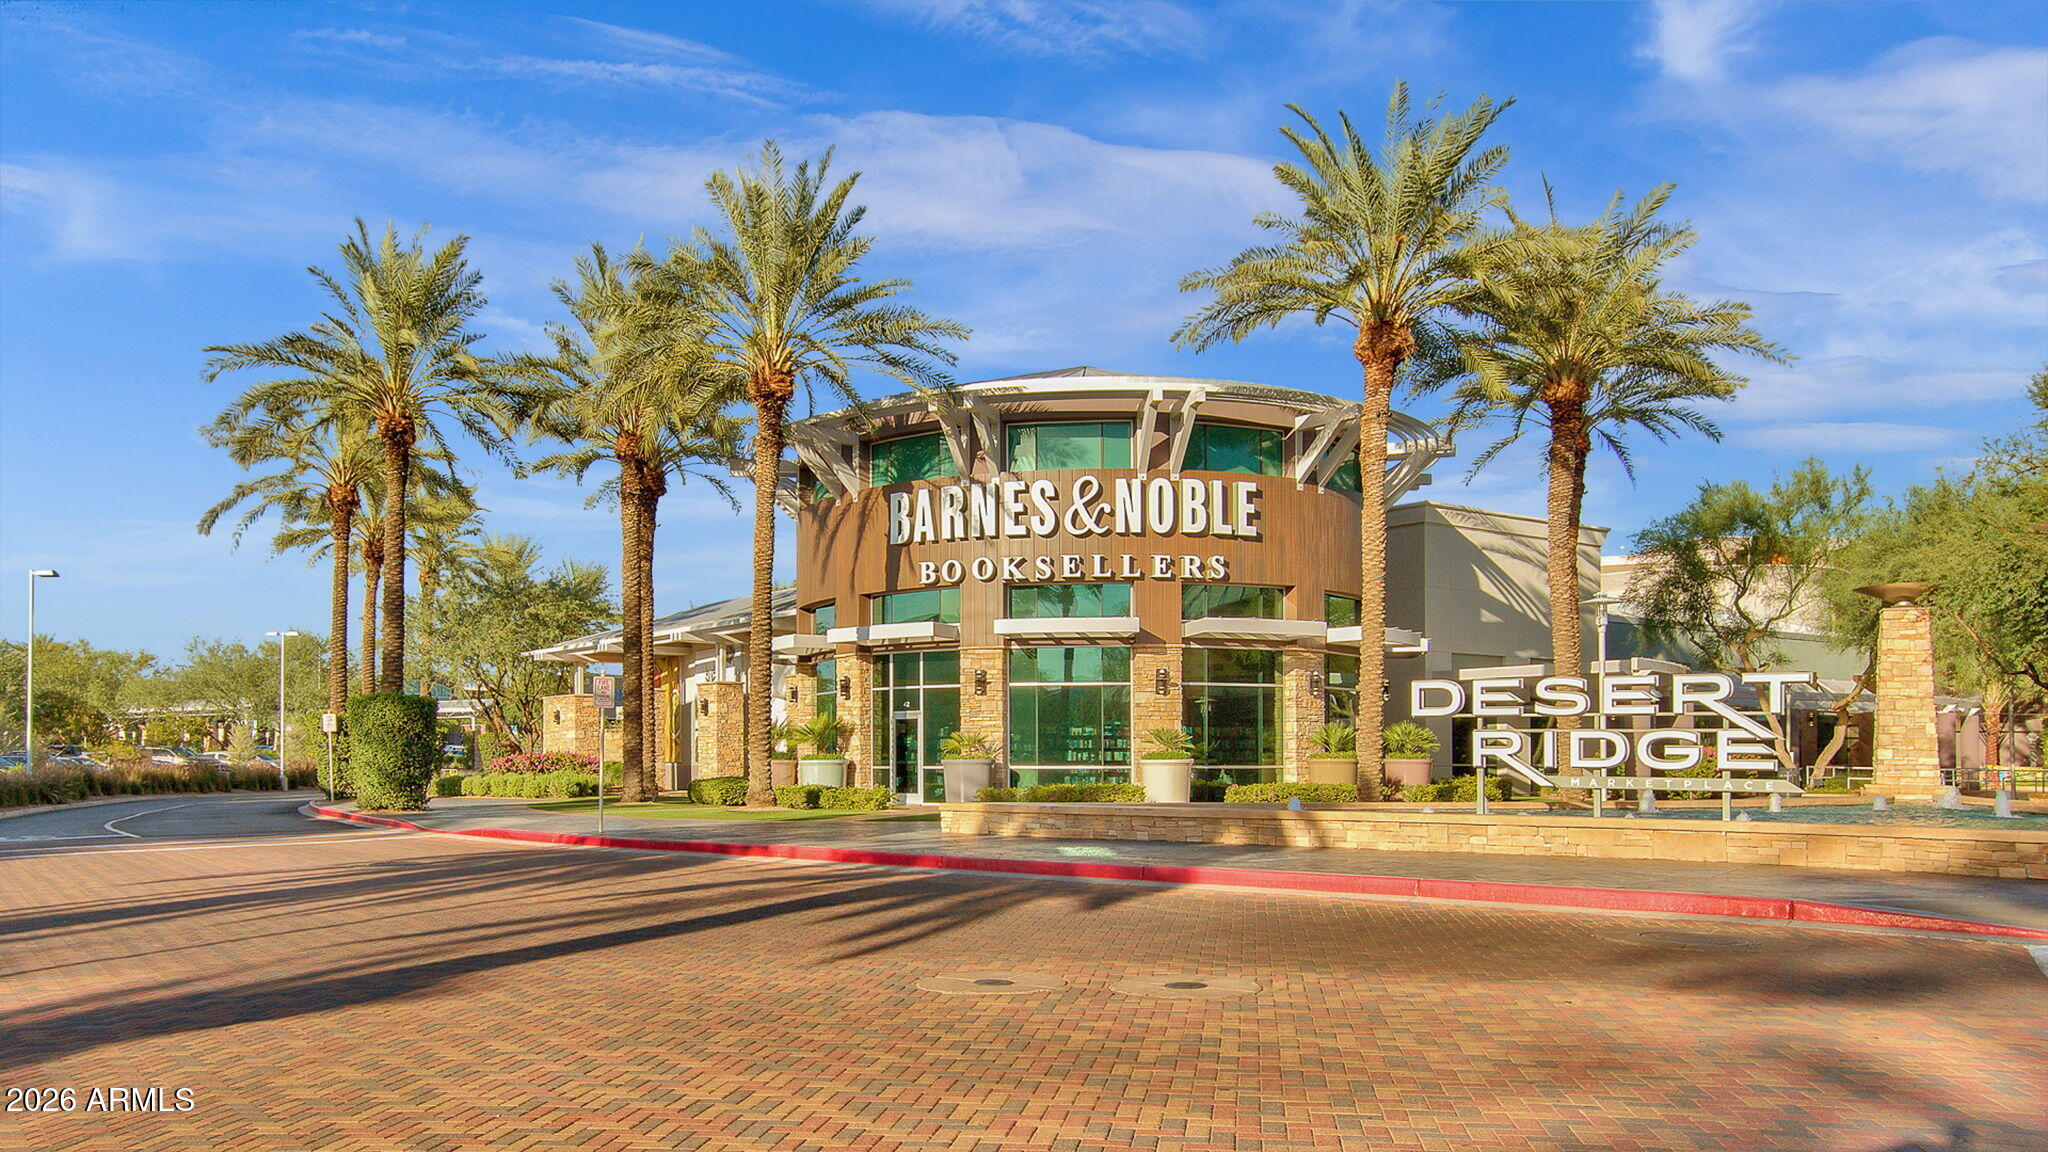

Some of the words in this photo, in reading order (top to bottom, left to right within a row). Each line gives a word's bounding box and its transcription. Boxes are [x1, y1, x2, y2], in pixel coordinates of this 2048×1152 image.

[889, 478, 1059, 545] BARNES
[1063, 475, 1115, 536] &
[1115, 477, 1261, 538] NOBLE
[918, 554, 1229, 585] BOOKSELLERS
[1411, 671, 1818, 740] DESERT
[1472, 729, 1779, 788] RIDGE
[1570, 778, 1775, 791] MARKETPLACE
